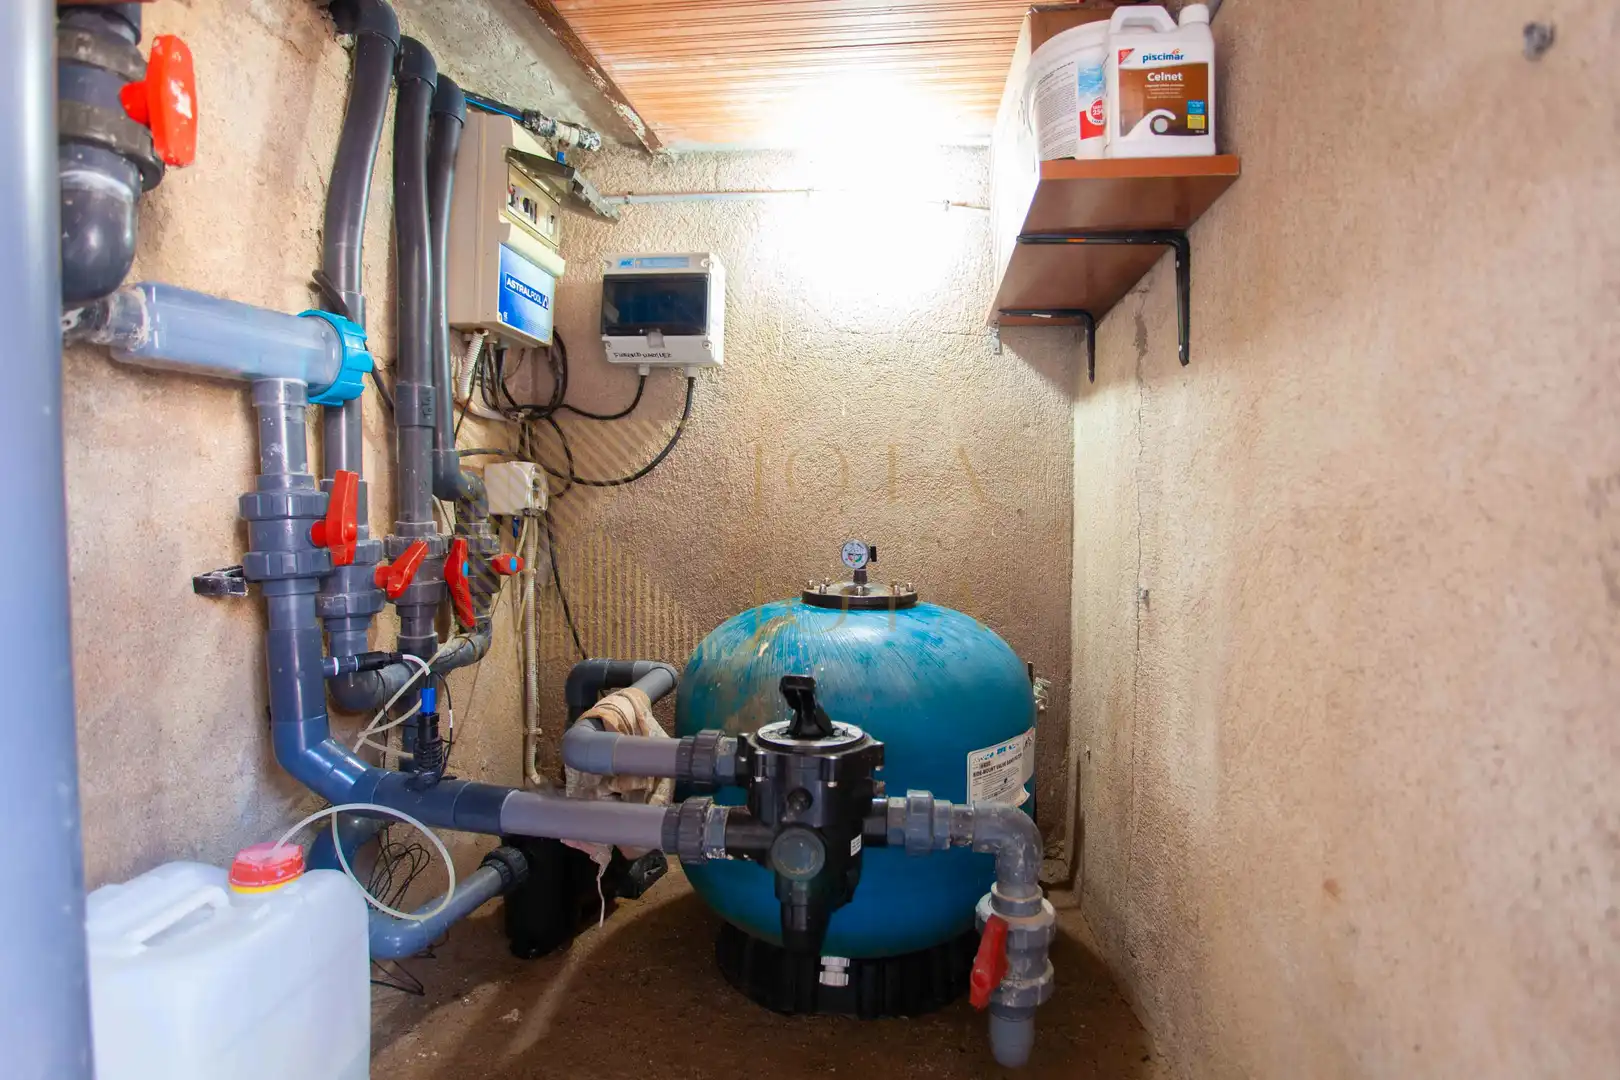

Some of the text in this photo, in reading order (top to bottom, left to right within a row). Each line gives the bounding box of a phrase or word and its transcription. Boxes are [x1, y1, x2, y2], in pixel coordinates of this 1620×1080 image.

[1142, 52, 1184, 64] piscimar
[1147, 72, 1183, 81] Celnet
[506, 277, 543, 305] ASTRALPOOL
